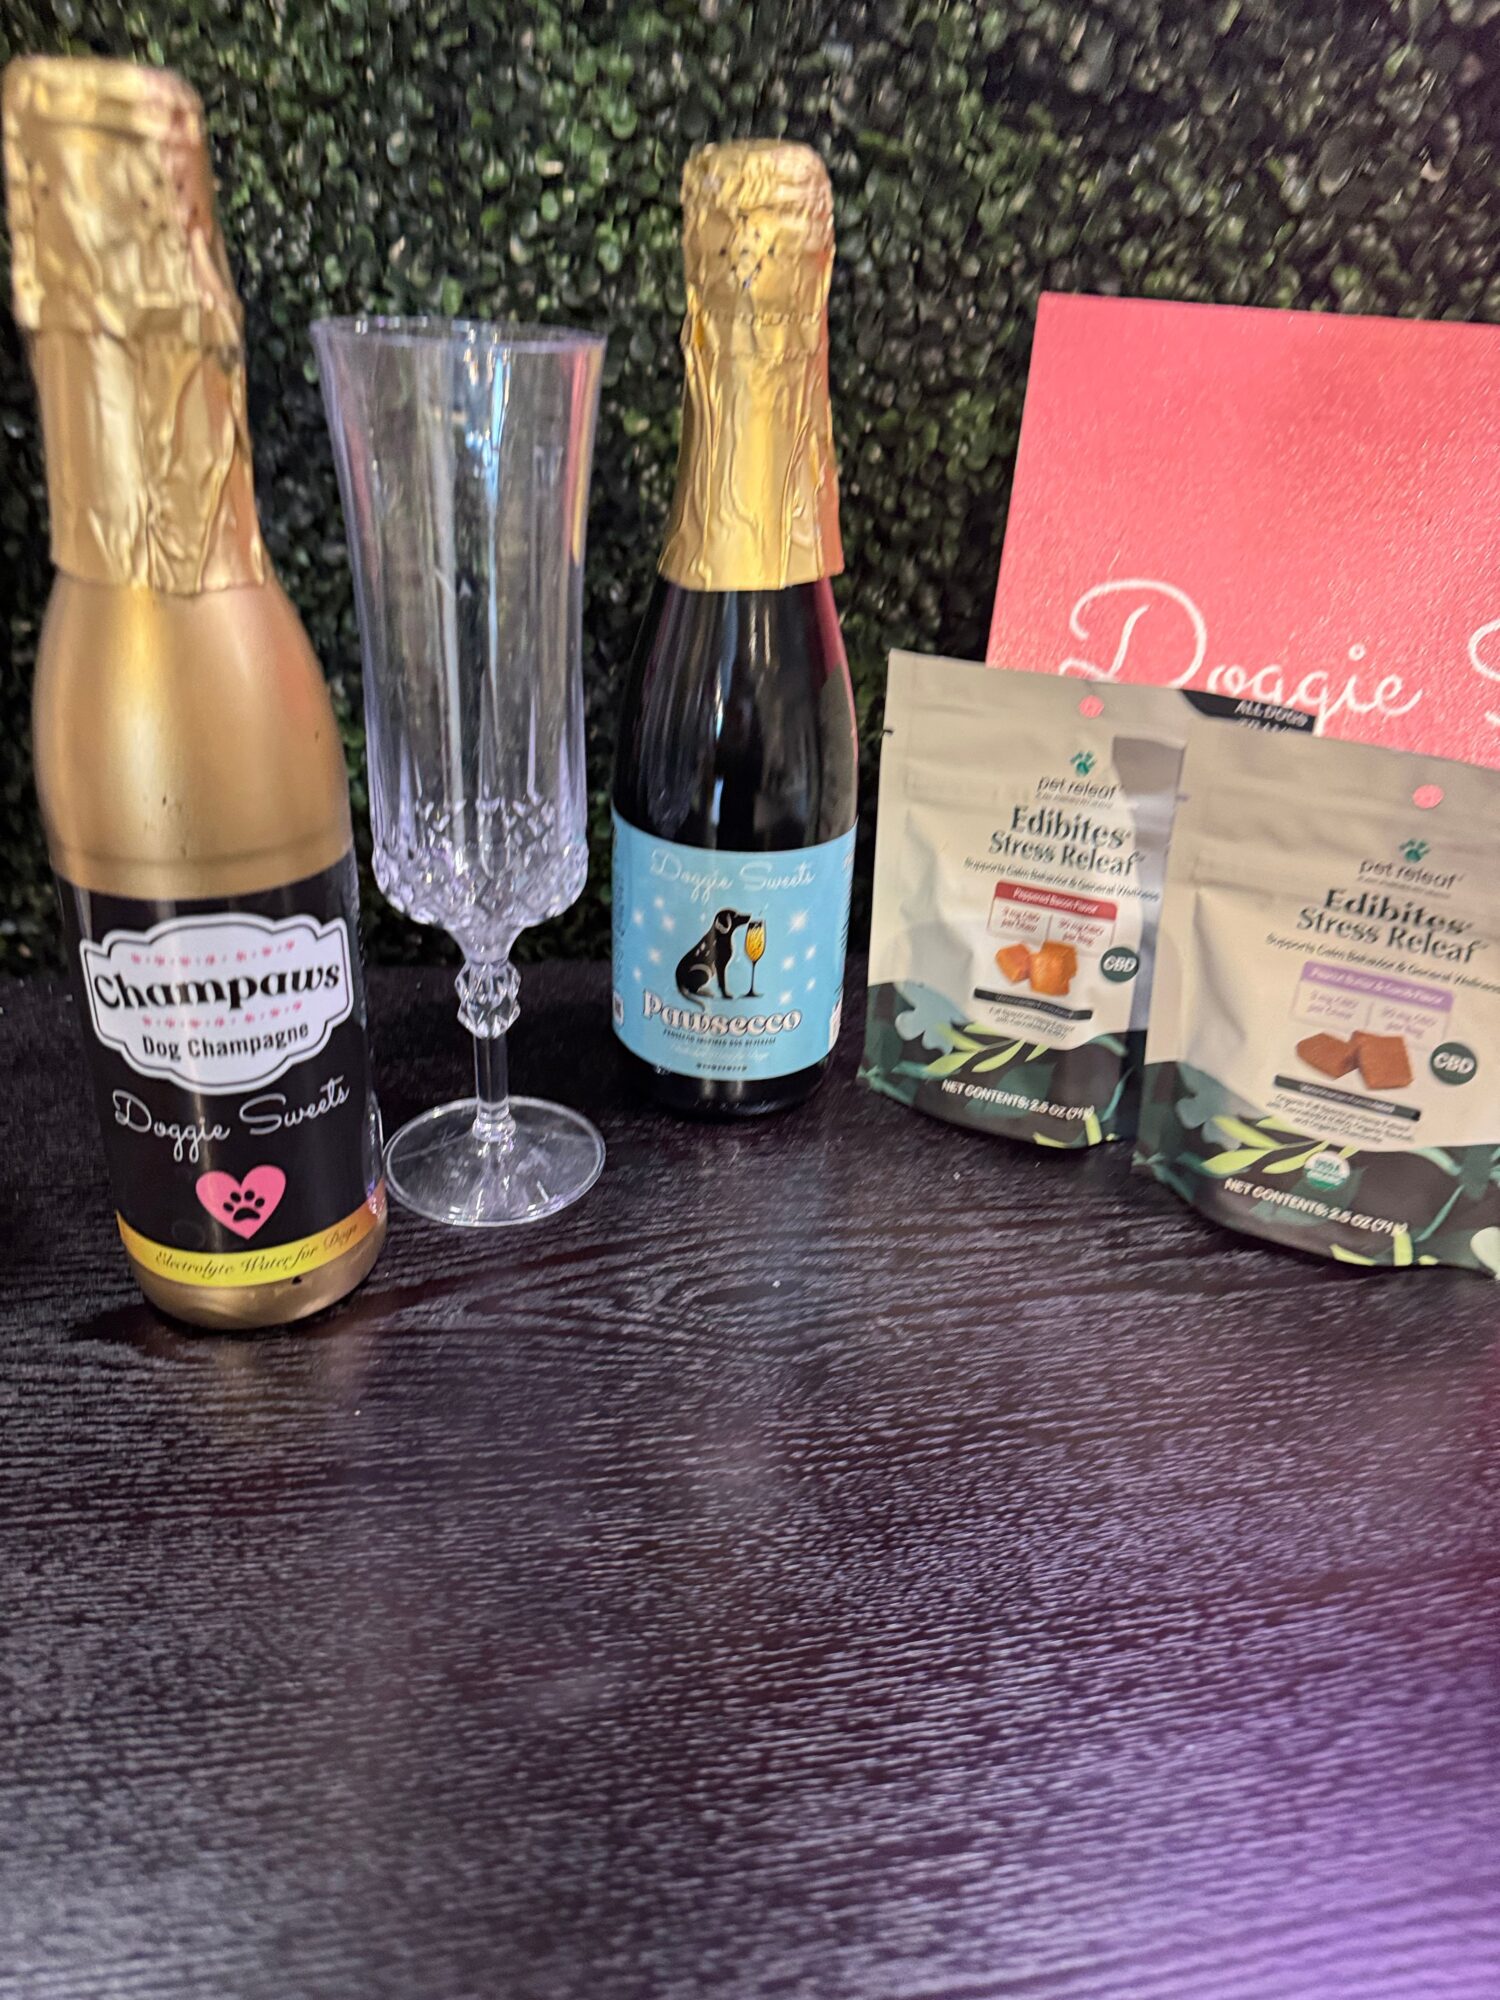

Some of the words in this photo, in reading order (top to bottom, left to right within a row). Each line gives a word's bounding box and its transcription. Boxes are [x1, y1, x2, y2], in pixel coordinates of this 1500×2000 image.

[1037, 777, 1063, 793] pet
[1067, 782, 1117, 800] releaf
[1010, 805, 1128, 849] Edibites
[989, 830, 1055, 864] Stress
[1059, 844, 1139, 877] Releaf
[650, 848, 733, 904] Doggie
[739, 859, 816, 892] Sweets
[1358, 860, 1393, 875] pet
[1396, 866, 1457, 889] releaf
[1325, 888, 1467, 934] Edibites
[1297, 907, 1379, 944] Stress
[1387, 926, 1482, 964] Releaf
[1103, 956, 1137, 973] CBD
[94, 964, 340, 1012] Champaws
[643, 988, 803, 1037] Pawsecco
[142, 1035, 182, 1061] Dog
[187, 1022, 309, 1060] Champagne
[1433, 1052, 1475, 1075] CBD
[941, 1079, 965, 1095] NET
[112, 1089, 231, 1162] Doggie
[239, 1075, 350, 1136] Sweets
[1224, 1177, 1254, 1195] NET
[155, 1251, 234, 1280] Electrolyte
[241, 1255, 291, 1273] Water
[288, 1243, 317, 1271] for
